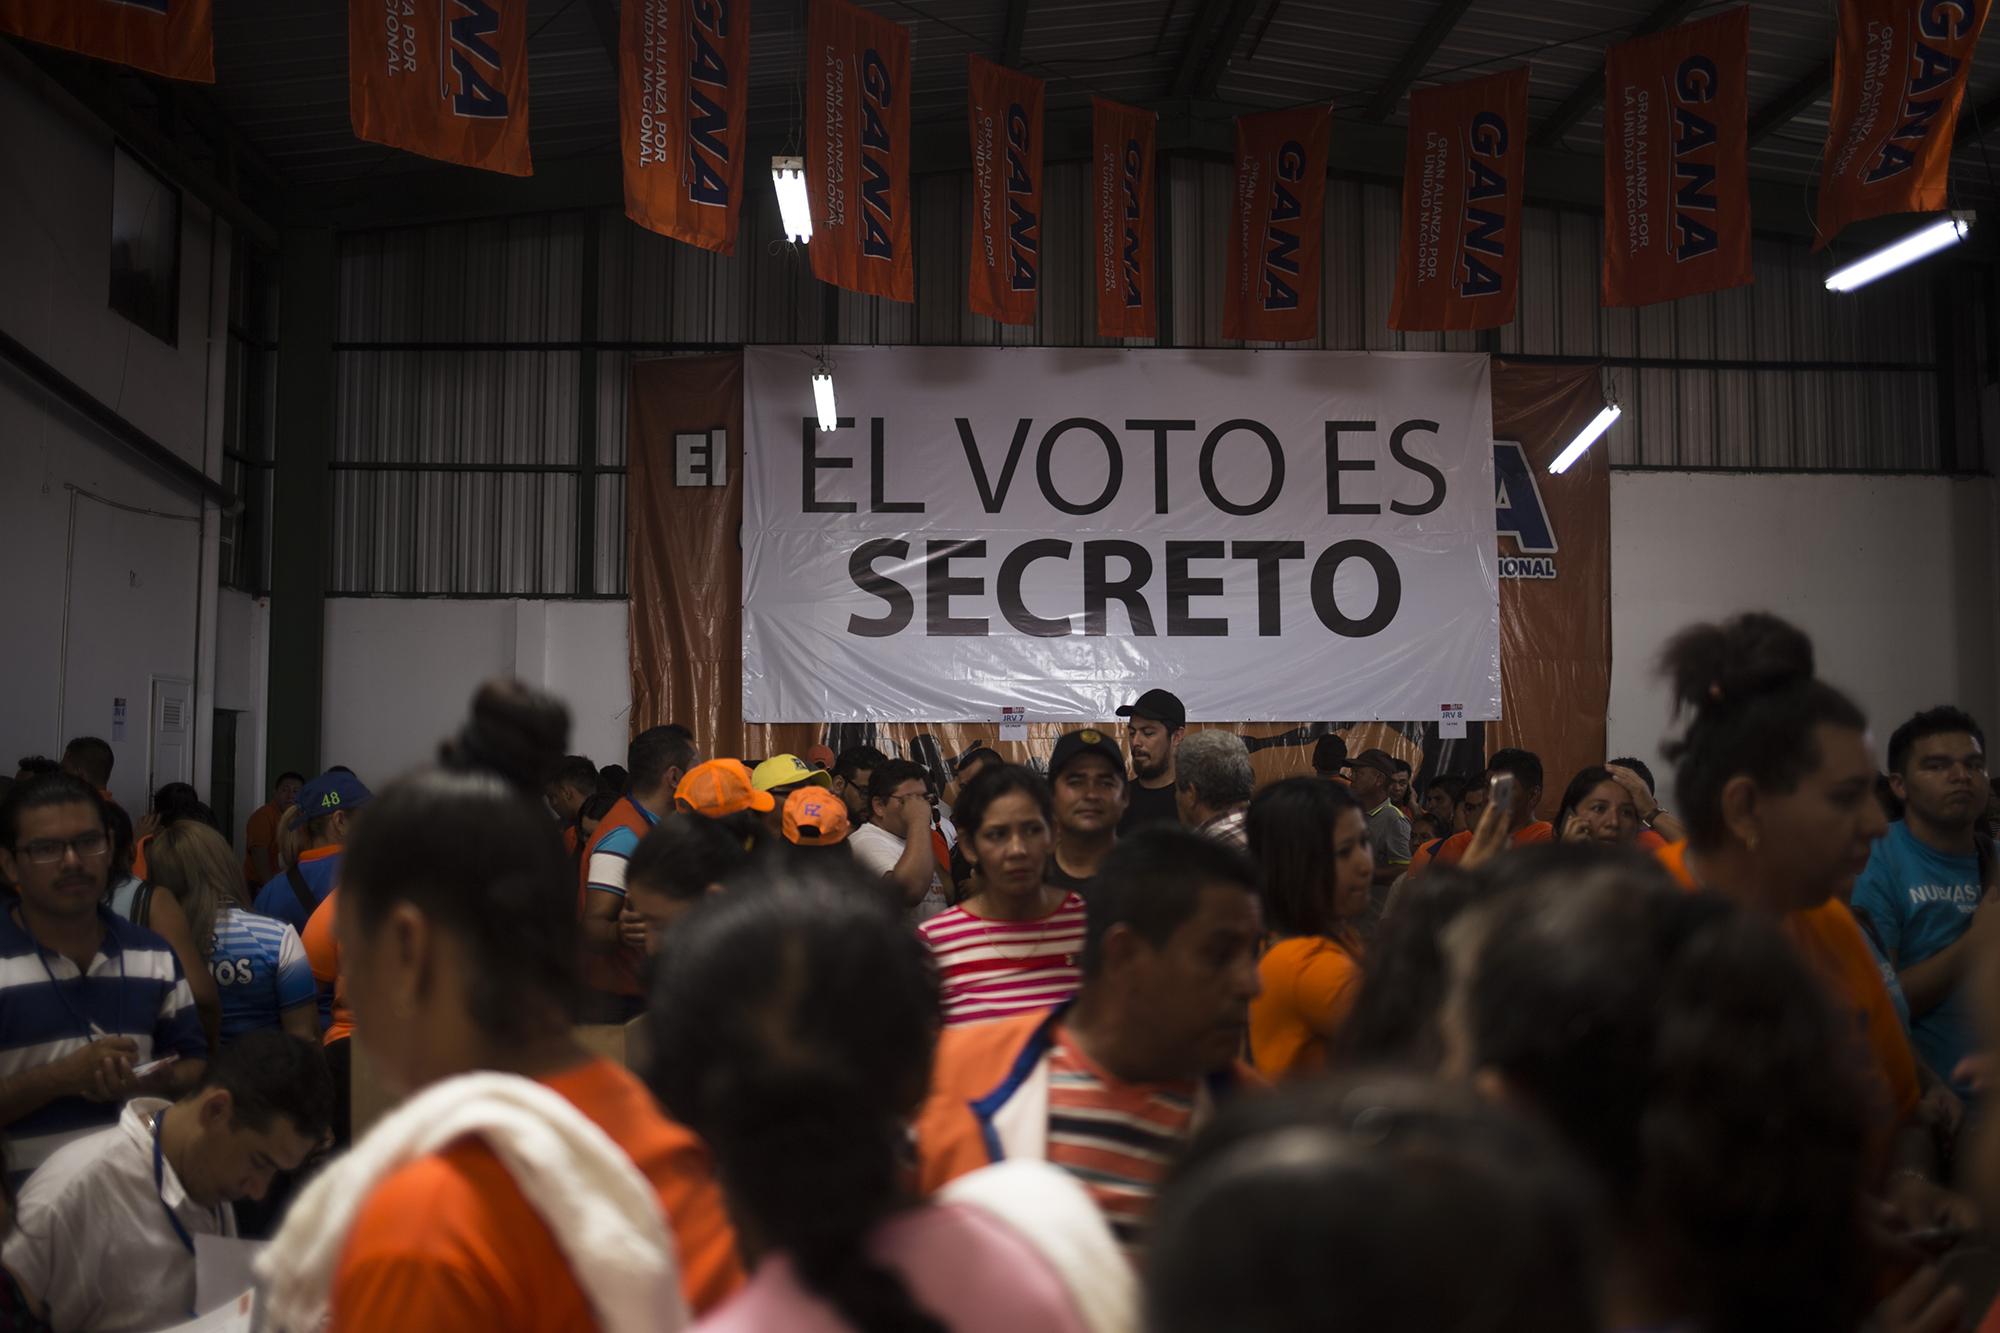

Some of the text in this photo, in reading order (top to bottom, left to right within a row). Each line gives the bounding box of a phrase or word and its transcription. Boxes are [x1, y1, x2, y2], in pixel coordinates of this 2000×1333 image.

[402, 24, 417, 73] POR
[655, 33, 668, 114] ALIANZA
[689, 0, 729, 208] GANA
[1623, 86, 1636, 106] LA
[1863, 0, 1976, 184] GANA
[1867, 21, 1881, 45] LA
[1877, 26, 1893, 77] GRAN
[639, 67, 654, 168] NACIONAL
[654, 121, 667, 162] POR
[824, 46, 837, 230] LA UNIDAD NACIONAL
[835, 58, 845, 225] GRAN ALIANZA POR
[861, 48, 892, 262] GANA
[1623, 110, 1635, 170] UNIDAD
[1636, 91, 1649, 247] GRAN ALIANZA POR
[1675, 54, 1718, 263] GANA
[1006, 103, 1036, 292] GANA
[1122, 139, 1142, 308] GANA
[1263, 139, 1307, 311] GANA
[1417, 132, 1438, 287] LA UNIDAD NACIONAL
[1426, 137, 1449, 278] GRAN ALIANZA POR
[1461, 112, 1508, 297] GANA
[803, 417, 1447, 516] EL VOTO ES
[847, 538, 1401, 638] SECRETO
[321, 791, 341, 808] 48
